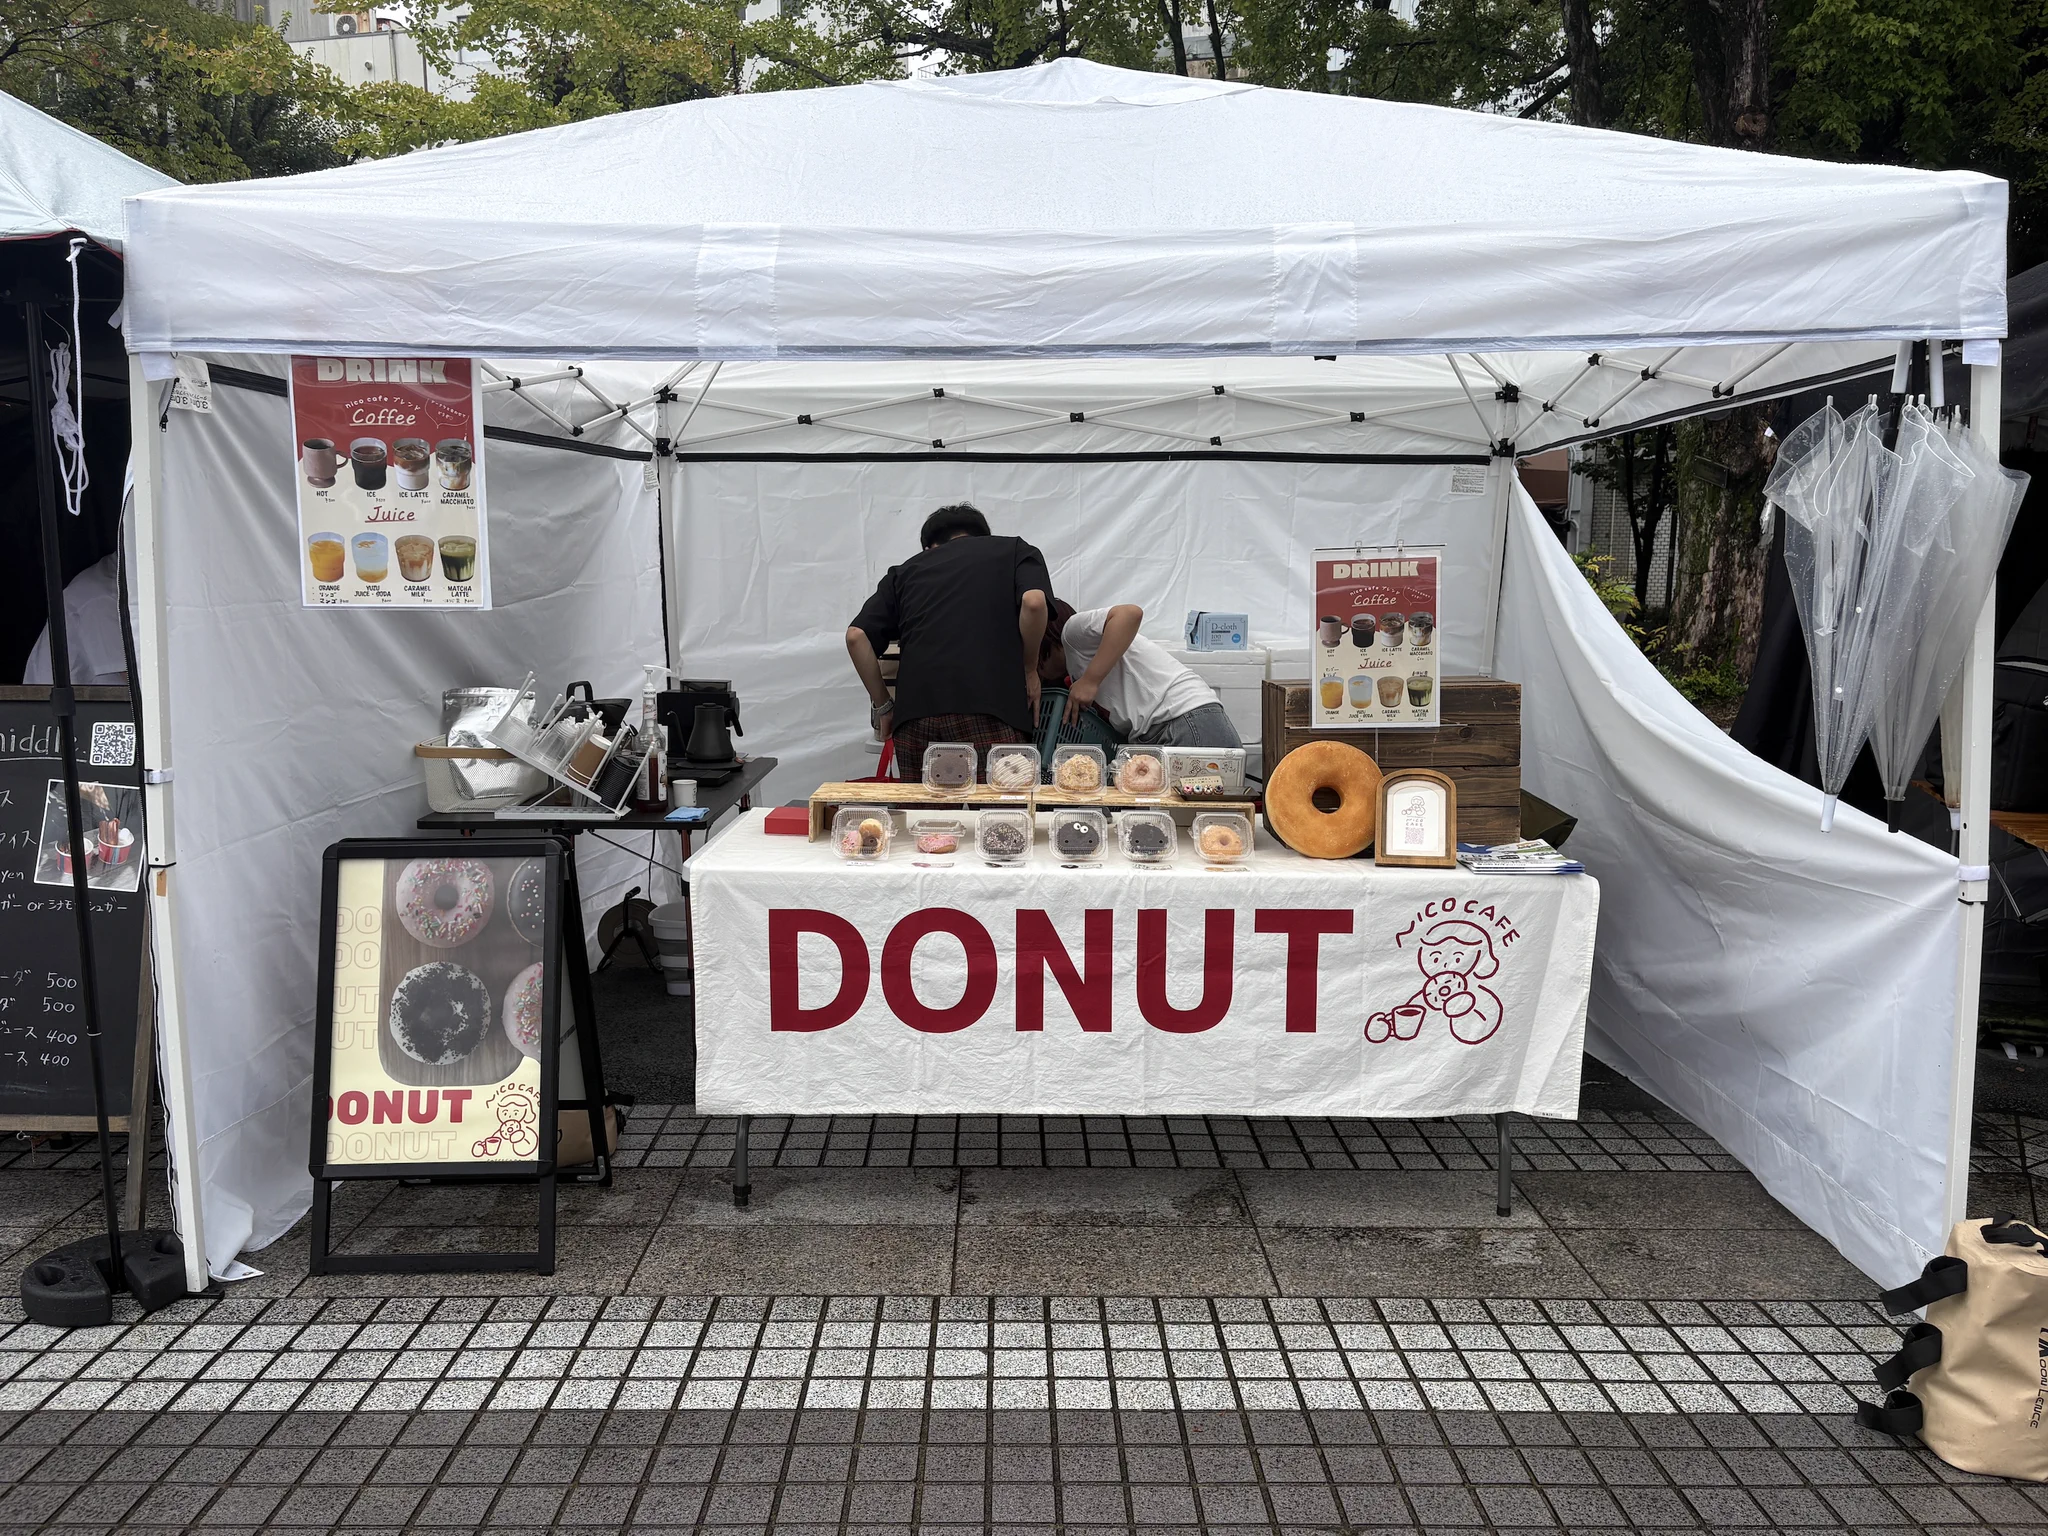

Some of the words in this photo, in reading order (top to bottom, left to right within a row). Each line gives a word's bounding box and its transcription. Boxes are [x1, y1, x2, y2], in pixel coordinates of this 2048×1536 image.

[317, 358, 447, 384] DRINK
[345, 397, 364, 409] nico
[366, 394, 389, 403] cafe
[352, 408, 417, 426] Coffee
[316, 490, 328, 498] HOT
[442, 491, 470, 499] CARAMEL
[440, 498, 475, 506] MACCHIATO
[367, 505, 416, 522] Juice
[1333, 561, 1419, 579] DRINK
[319, 584, 341, 592] ORANGE
[1354, 594, 1397, 606] Coffee
[1359, 658, 1392, 668] Juice
[1, 870, 24, 883] yen
[27, 902, 44, 911] or
[48, 896, 127, 912] シナモシュガー
[768, 907, 1354, 1034] DONUT
[47, 972, 77, 988] 500
[43, 996, 75, 1013] 500
[46, 1029, 77, 1044] 400
[40, 1053, 70, 1066] 400
[328, 1089, 472, 1125] ONUT
